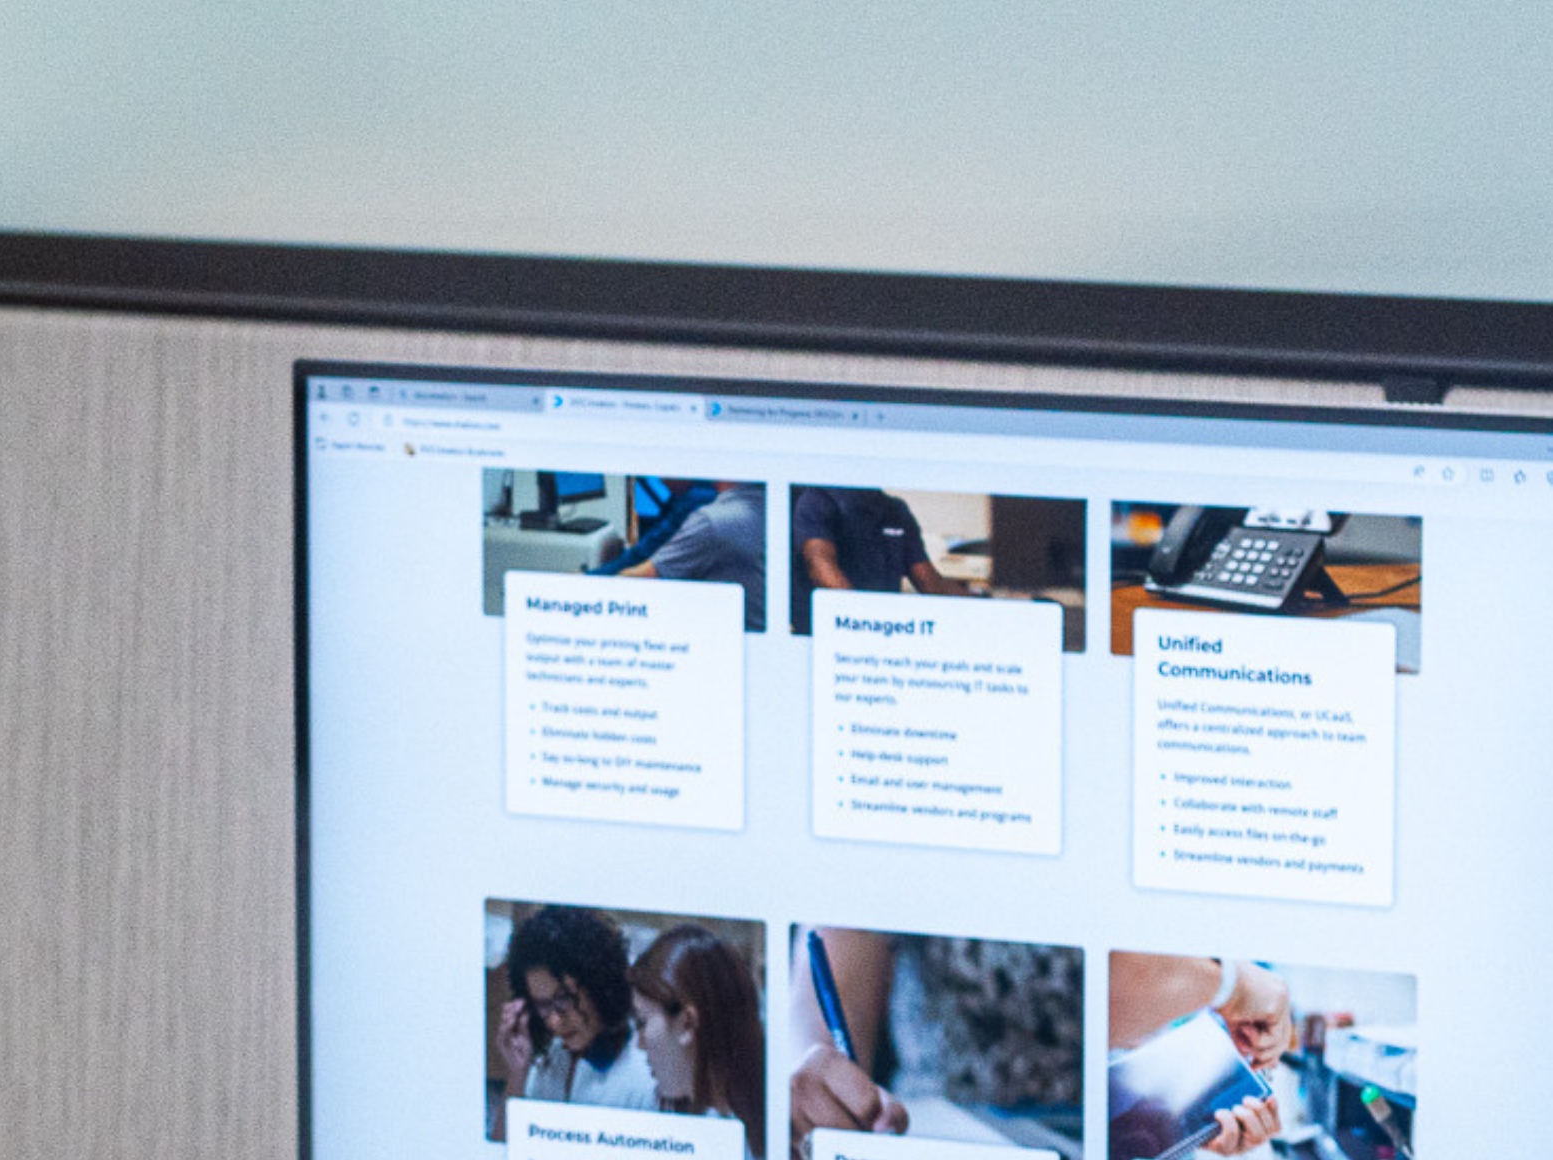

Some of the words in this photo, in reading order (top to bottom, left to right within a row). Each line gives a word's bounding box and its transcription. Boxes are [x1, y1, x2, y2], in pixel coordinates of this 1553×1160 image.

[526, 597, 603, 617] Managed
[608, 601, 648, 617] Print
[835, 616, 915, 637] Managed
[920, 621, 935, 635] IT
[575, 638, 596, 649] your
[600, 638, 641, 652] printing
[670, 643, 689, 652] and
[1158, 635, 1223, 653] Unified
[526, 653, 559, 664] output
[564, 654, 585, 664] with
[589, 658, 594, 666] a
[598, 657, 622, 667] team
[627, 657, 637, 667] of
[835, 652, 879, 666] Securely
[884, 656, 912, 667] reach
[915, 660, 937, 669] your
[942, 661, 969, 672] goals
[973, 662, 992, 673] and
[996, 664, 1022, 674] scale
[526, 671, 583, 683] technicians
[587, 675, 606, 685] and
[835, 673, 858, 683] your
[862, 674, 888, 684] team
[892, 675, 904, 688] by
[908, 677, 971, 693] outsourcing
[974, 680, 982, 691] IT
[987, 682, 1013, 693] tasks
[1018, 686, 1028, 694] to
[1158, 661, 1313, 686] Communications
[835, 693, 851, 702] our
[543, 702, 569, 713] Track
[602, 707, 620, 717] and
[624, 708, 657, 720] output
[1157, 699, 1198, 712] Unified
[1301, 710, 1311, 719] or
[543, 726, 589, 740] Eliminate
[593, 730, 627, 741] hidden
[851, 723, 900, 737] Eliminate
[904, 726, 957, 741] downtime
[1157, 719, 1189, 731] offers
[1193, 723, 1198, 732] a
[1202, 721, 1264, 736] centralized
[1267, 727, 1319, 741] approach
[1323, 732, 1333, 741] to
[1337, 731, 1367, 743] team
[543, 752, 558, 763] Say
[603, 757, 611, 765] to
[635, 759, 701, 772] maintenance
[907, 755, 948, 766] support
[543, 777, 581, 792] Manage
[586, 780, 625, 795] security
[629, 785, 646, 795] and
[651, 787, 679, 798] usage
[851, 774, 879, 786] Email
[884, 777, 902, 787] and
[906, 781, 929, 789] user
[933, 781, 1003, 795] management
[1174, 772, 1227, 785] Improved
[1231, 775, 1291, 790] interaction
[851, 799, 907, 814] Streamline
[912, 804, 954, 816] vendors
[958, 807, 977, 818] and
[980, 809, 1031, 824] programs
[1174, 797, 1237, 812] Collaborate
[1241, 803, 1265, 814] with
[1269, 806, 1308, 818] remote
[1313, 807, 1338, 819] staff
[1174, 824, 1204, 837] Easily
[1208, 827, 1243, 838] access
[1247, 828, 1268, 840] files
[1174, 849, 1232, 864] Streamline
[1237, 854, 1280, 867] vendors
[1284, 859, 1305, 869] and
[1308, 861, 1363, 874] payments
[528, 1123, 591, 1144] Process
[597, 1131, 695, 1154] Automation
